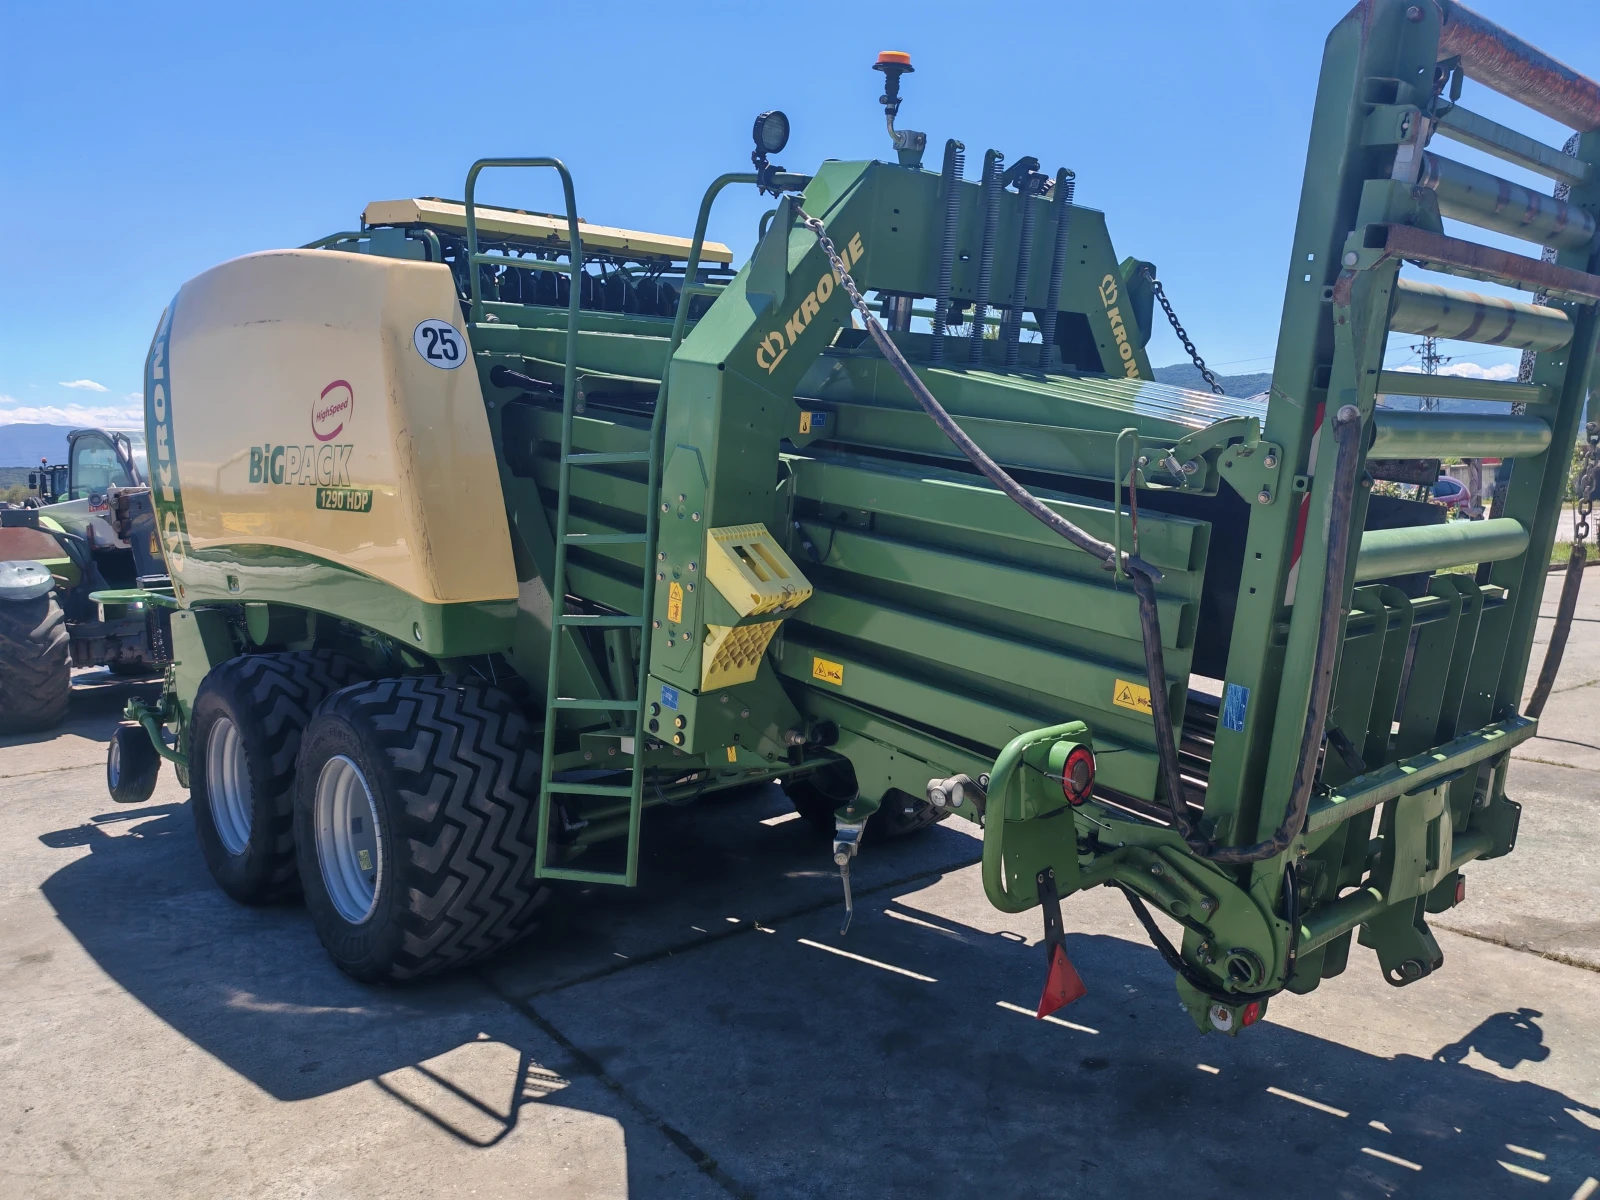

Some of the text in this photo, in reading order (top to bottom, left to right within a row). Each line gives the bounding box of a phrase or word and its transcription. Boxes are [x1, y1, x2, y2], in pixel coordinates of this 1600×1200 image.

[422, 326, 459, 361] 25
[1106, 306, 1140, 379] KRON
[315, 396, 349, 422] HighSpeed
[320, 489, 369, 511] 1290 HDP
